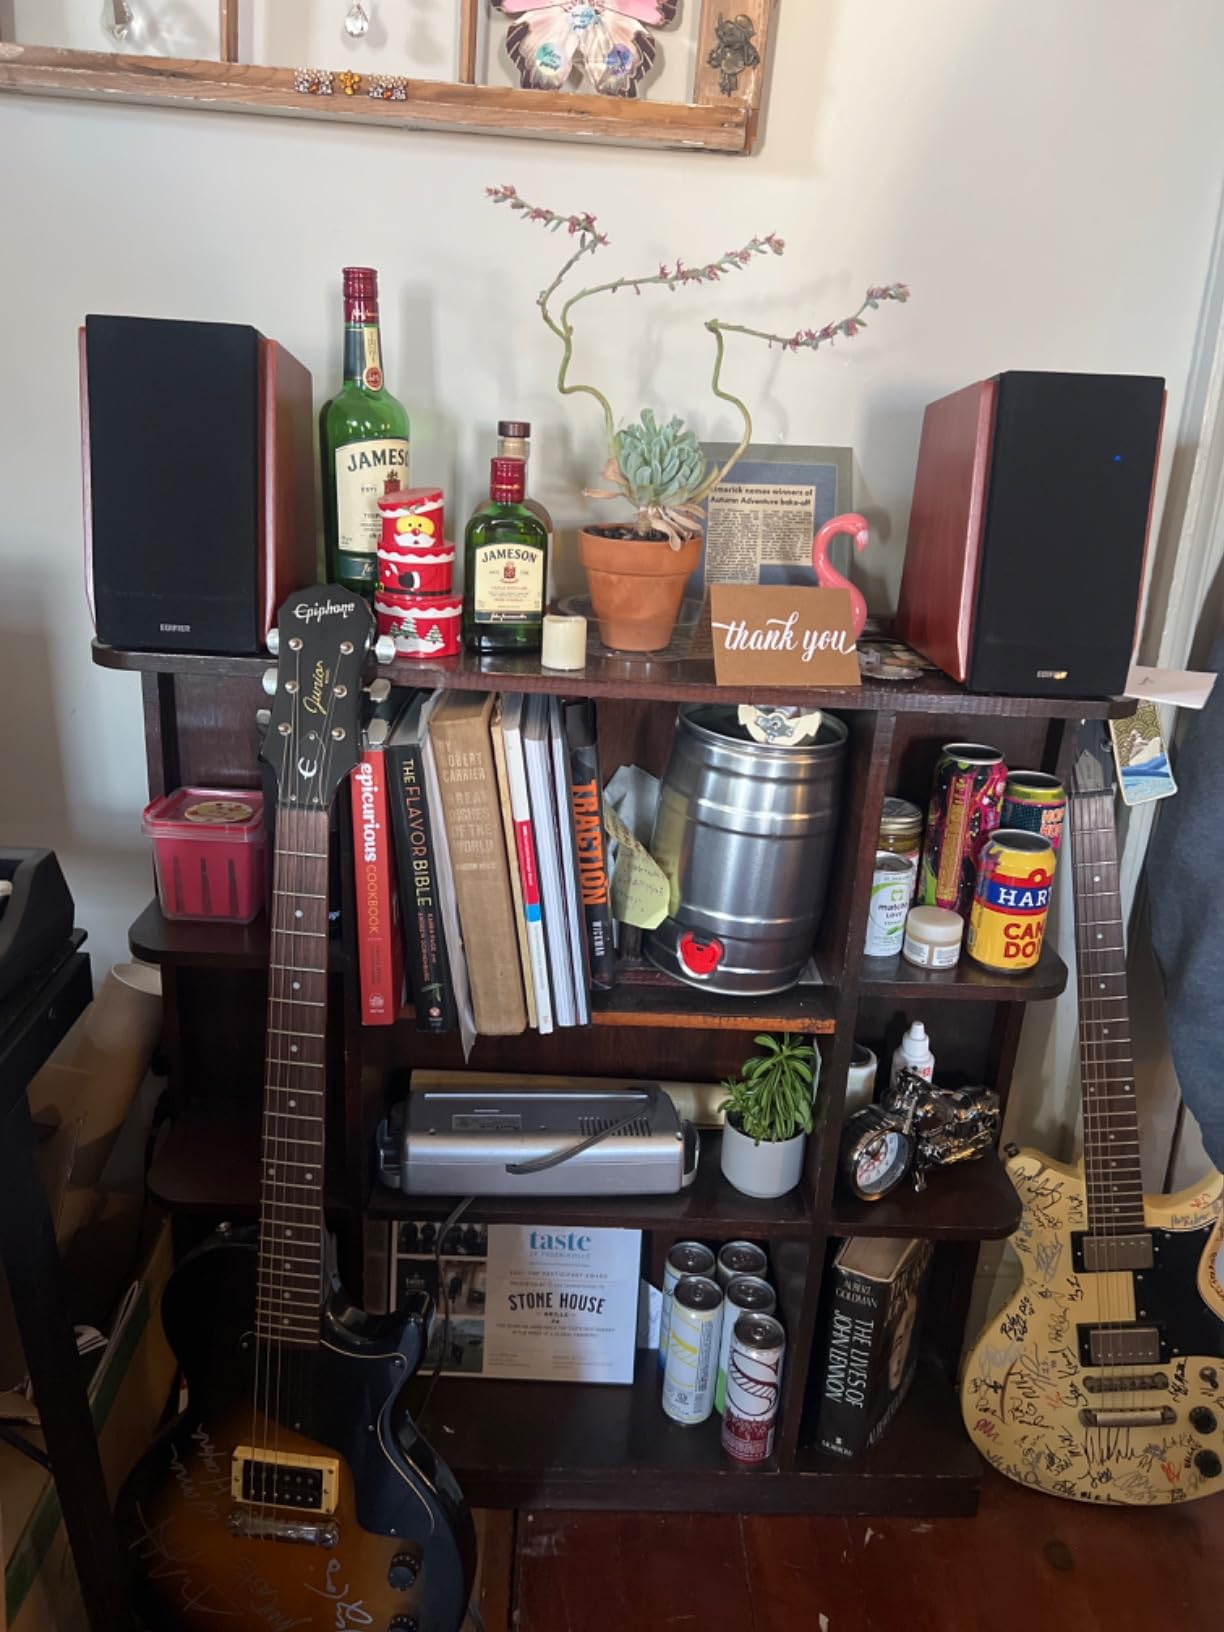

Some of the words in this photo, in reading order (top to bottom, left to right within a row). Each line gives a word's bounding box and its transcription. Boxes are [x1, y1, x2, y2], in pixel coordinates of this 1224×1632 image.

[741, 496, 778, 505] Adventure
[482, 548, 537, 563] JAMESON
[293, 600, 356, 625] Epiphone
[711, 611, 800, 651] thank
[801, 627, 857, 662] you
[302, 659, 328, 716] Junior
[402, 758, 416, 784] THE
[443, 767, 486, 783] CARRIER
[355, 762, 380, 862] epicurious
[405, 786, 428, 857] FLAVOR
[571, 778, 609, 905] TRACTION
[412, 859, 432, 907] BIBLE
[997, 886, 1052, 907] HAR
[366, 864, 379, 934] COOKBOOK
[1003, 939, 1041, 958] DO
[529, 1231, 592, 1251] taste
[507, 1292, 554, 1312] STONE
[559, 1292, 607, 1315] HOUSE
[830, 1308, 853, 1349] JOHN
[852, 1319, 875, 1347] THE
[847, 1347, 871, 1389] LIVES
[844, 1388, 865, 1409] OF
